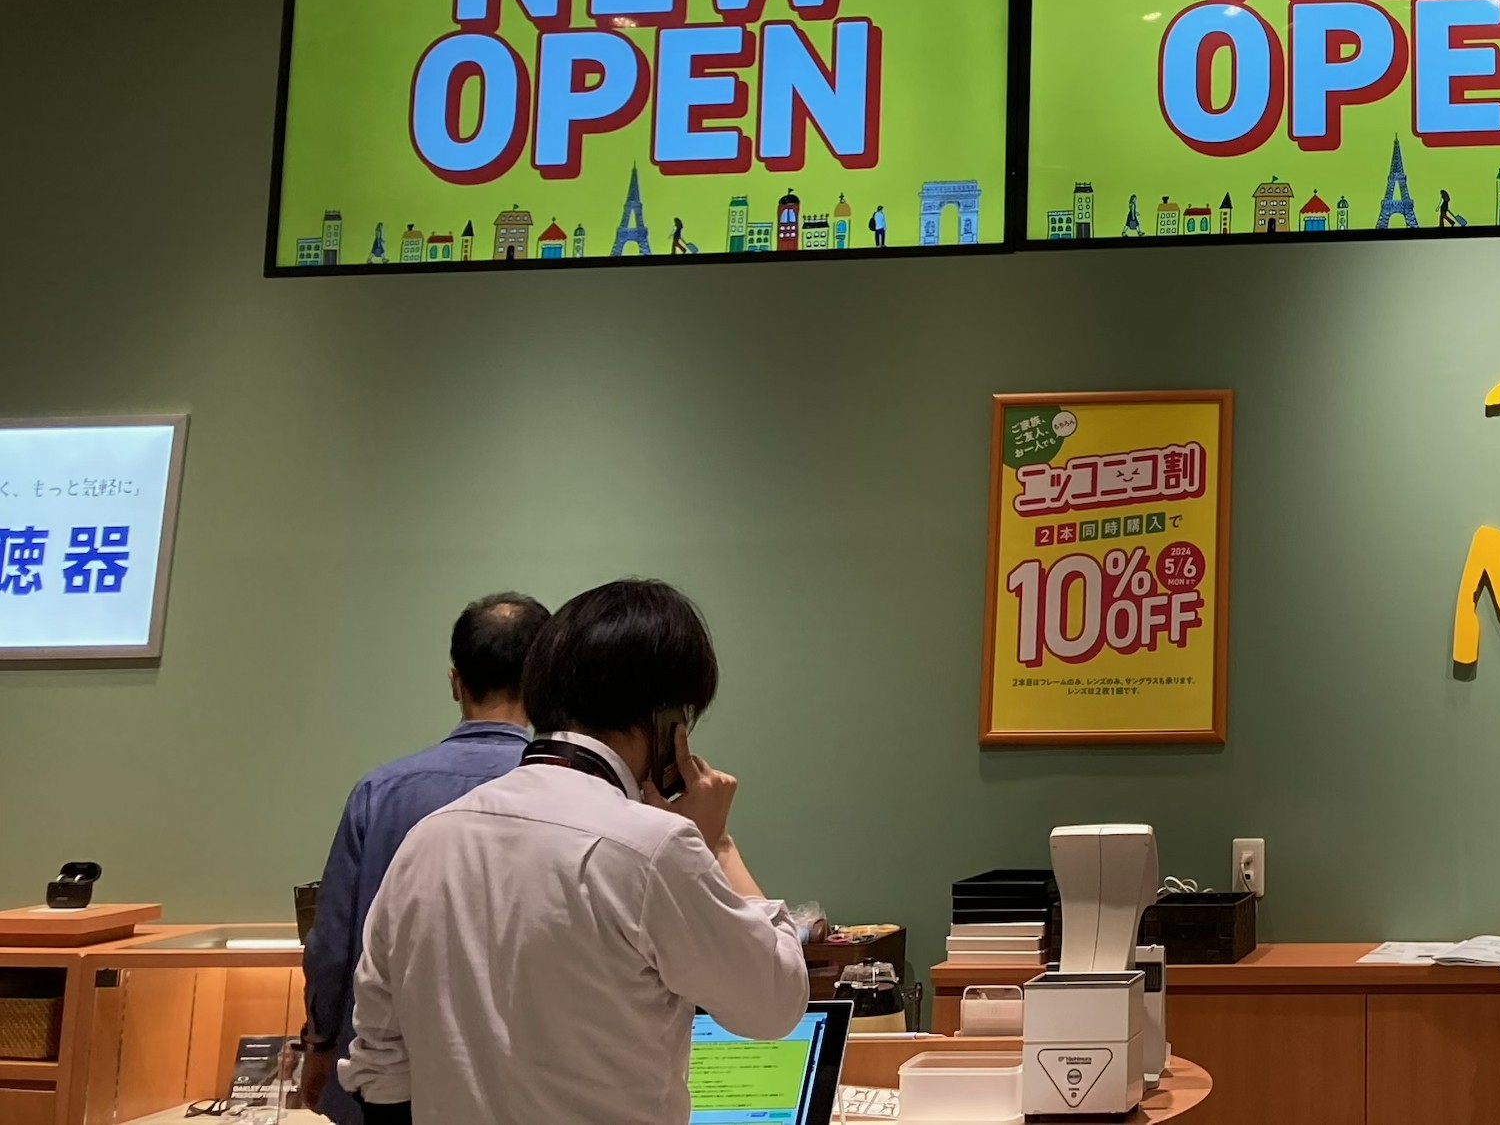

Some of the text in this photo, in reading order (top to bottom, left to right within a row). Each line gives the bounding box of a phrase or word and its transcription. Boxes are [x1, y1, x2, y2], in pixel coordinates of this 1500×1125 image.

[409, 16, 882, 184] OPEN
[1015, 443, 1202, 513] ニッコニコ割
[1164, 557, 1197, 578] 5/6
[1170, 547, 1192, 556] 2024
[1007, 546, 1154, 666] 10%
[1105, 592, 1203, 653] OFF
